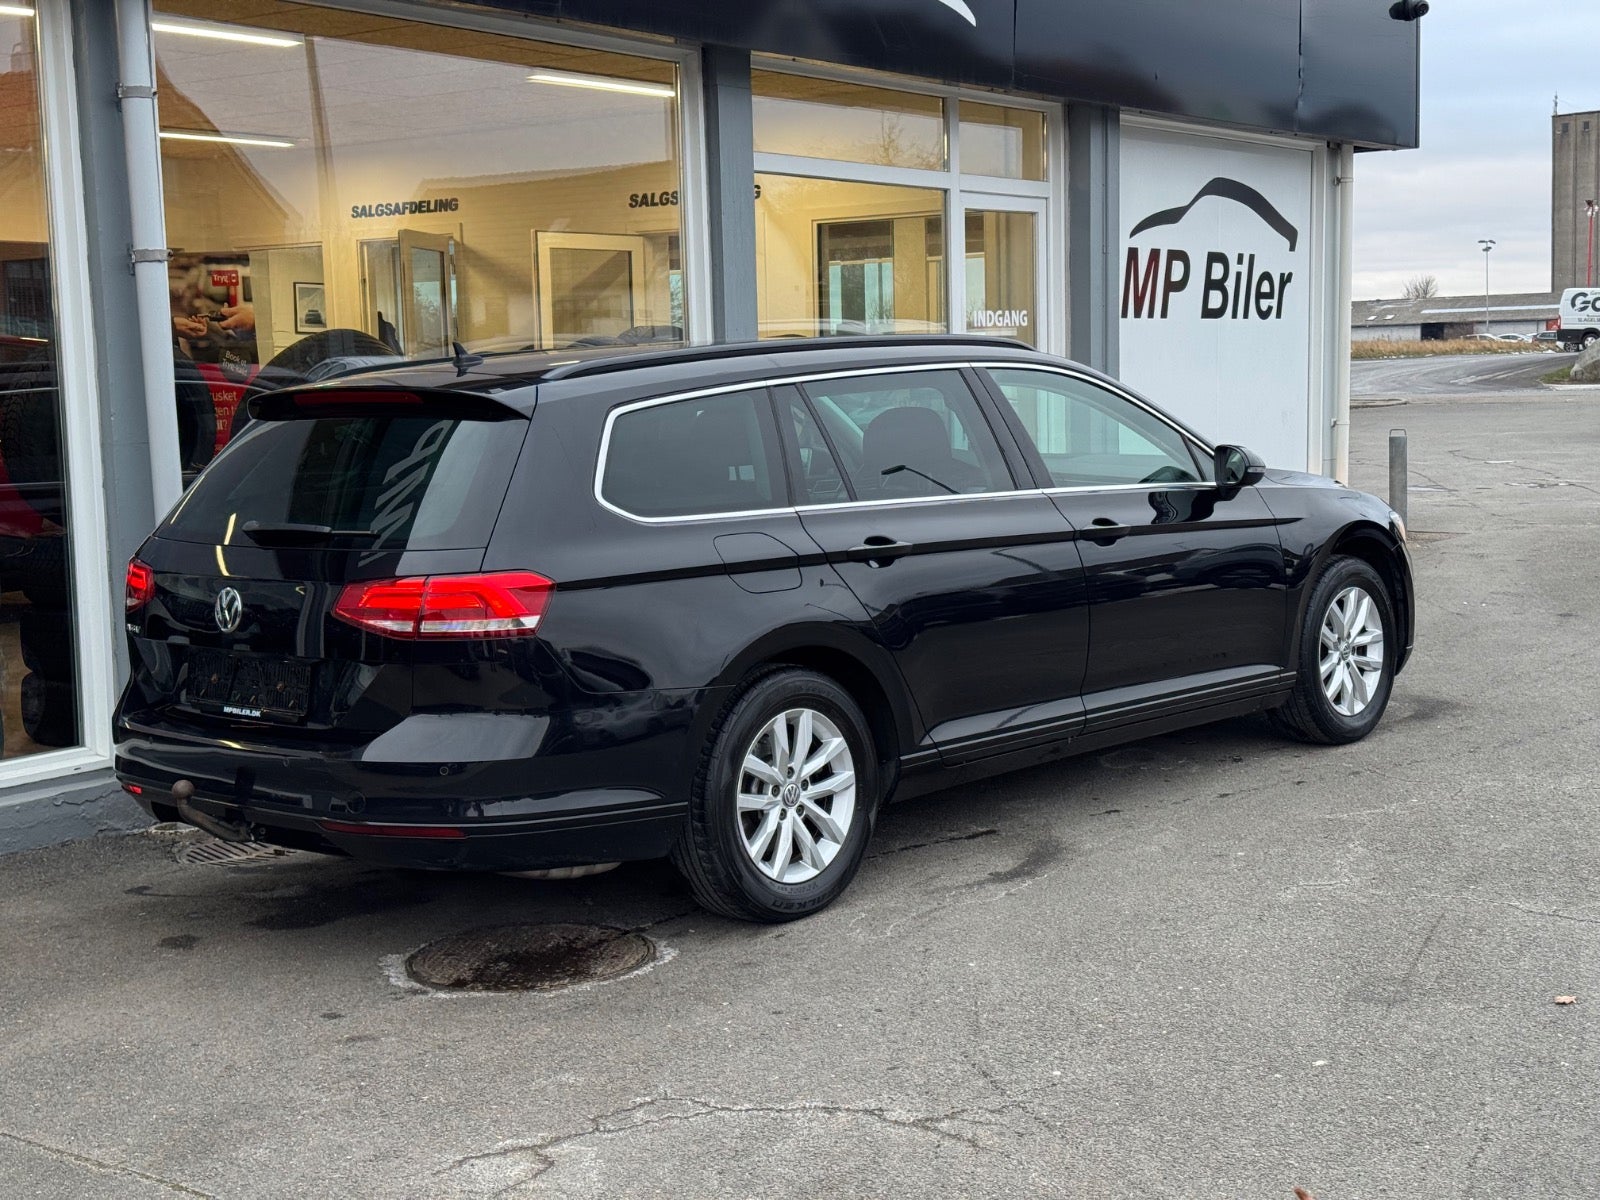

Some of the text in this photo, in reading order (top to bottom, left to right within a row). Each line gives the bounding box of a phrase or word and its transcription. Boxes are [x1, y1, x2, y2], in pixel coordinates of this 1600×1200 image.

[351, 198, 459, 218] SALGSAFDELING
[1121, 247, 1293, 320] MP Biler
[973, 310, 1028, 327] INDGANG
[210, 390, 237, 402] usket
